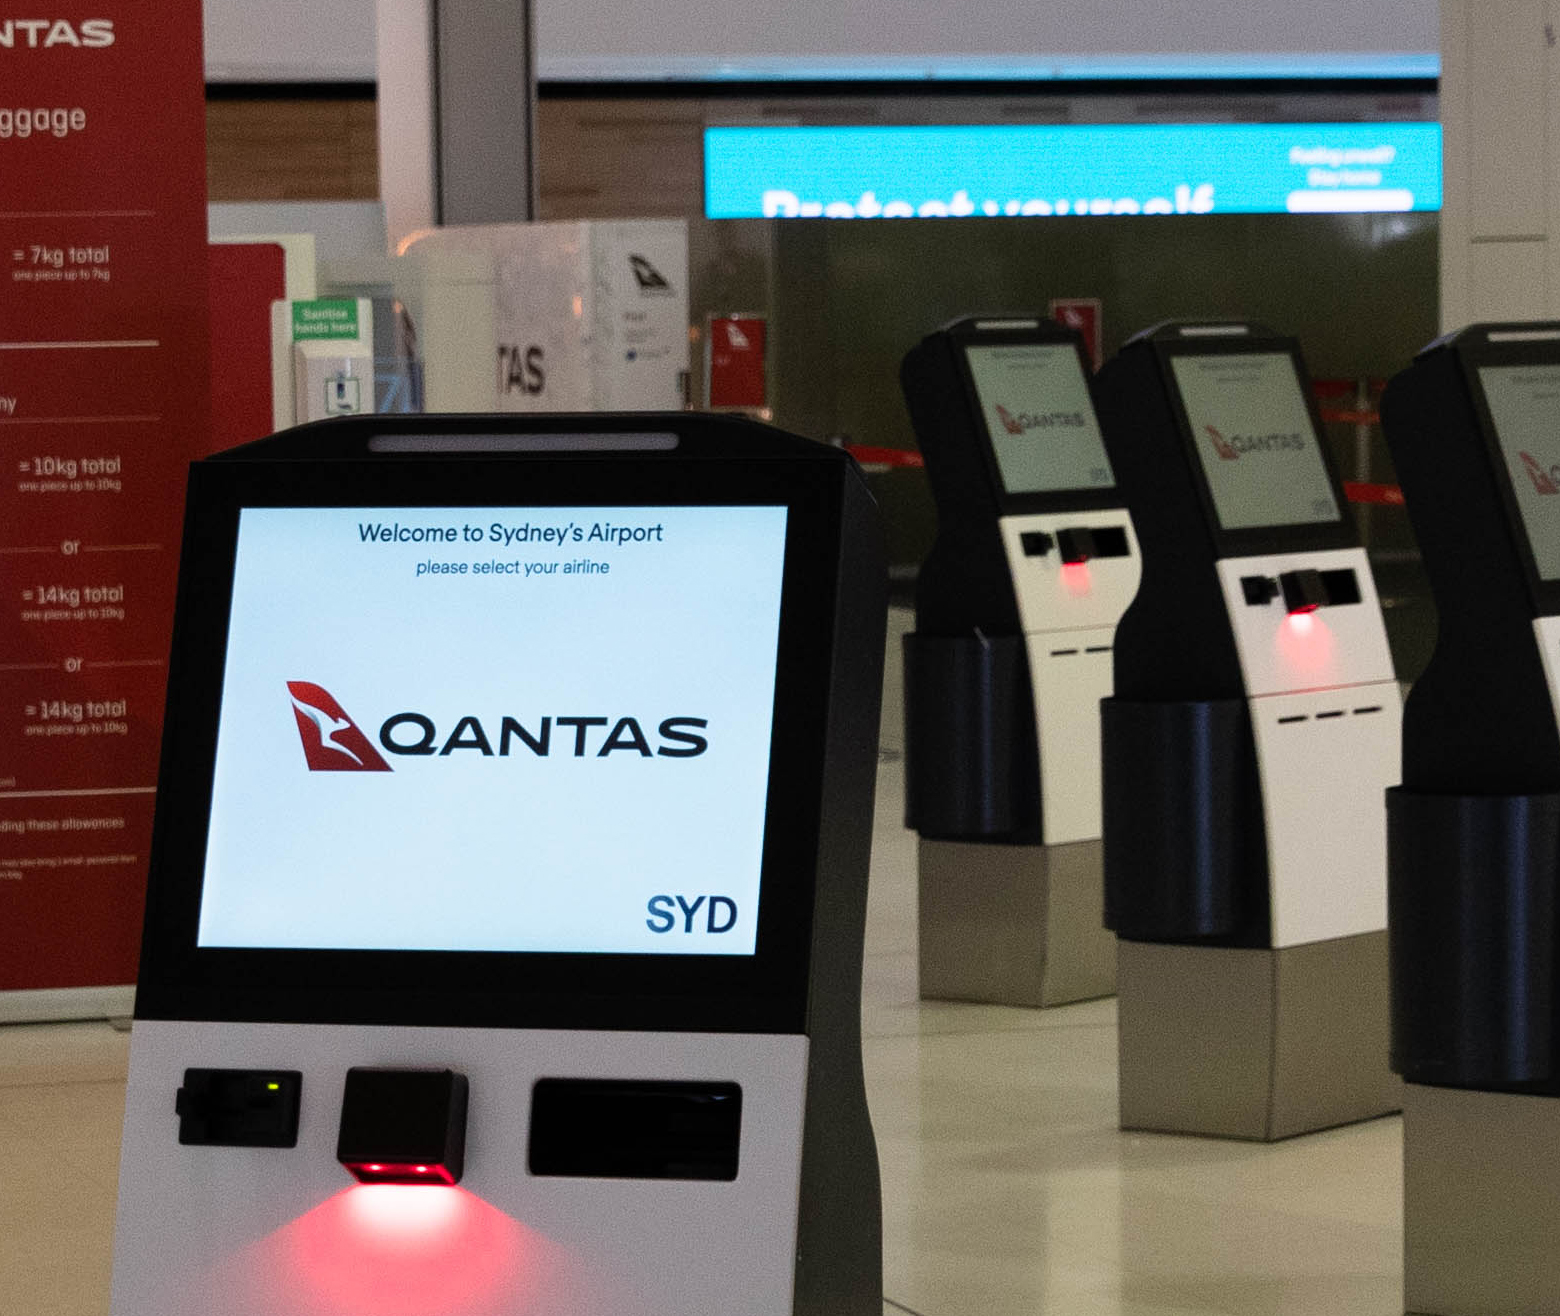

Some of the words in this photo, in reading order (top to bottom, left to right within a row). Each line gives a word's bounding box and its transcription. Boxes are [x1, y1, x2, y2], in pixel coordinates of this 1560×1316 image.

[31, 246, 64, 267] 7kg
[69, 245, 110, 264] total
[34, 457, 78, 479] 10kg
[81, 455, 121, 474] total
[358, 522, 458, 542] Welcome
[464, 523, 484, 542] to
[489, 522, 584, 546] Sydney's
[588, 522, 664, 546] Airport
[61, 540, 80, 556] or
[416, 559, 468, 577] please
[472, 559, 520, 575] select
[524, 562, 560, 577] your
[563, 559, 610, 575] airline
[37, 585, 80, 608] 14kg
[84, 585, 124, 603] total
[64, 657, 83, 673] or
[41, 700, 83, 722] 14kg
[87, 700, 127, 718] total
[378, 711, 709, 758] QANTAS
[27, 818, 60, 831] these
[62, 817, 125, 831] allowances
[645, 893, 738, 935] SYD
